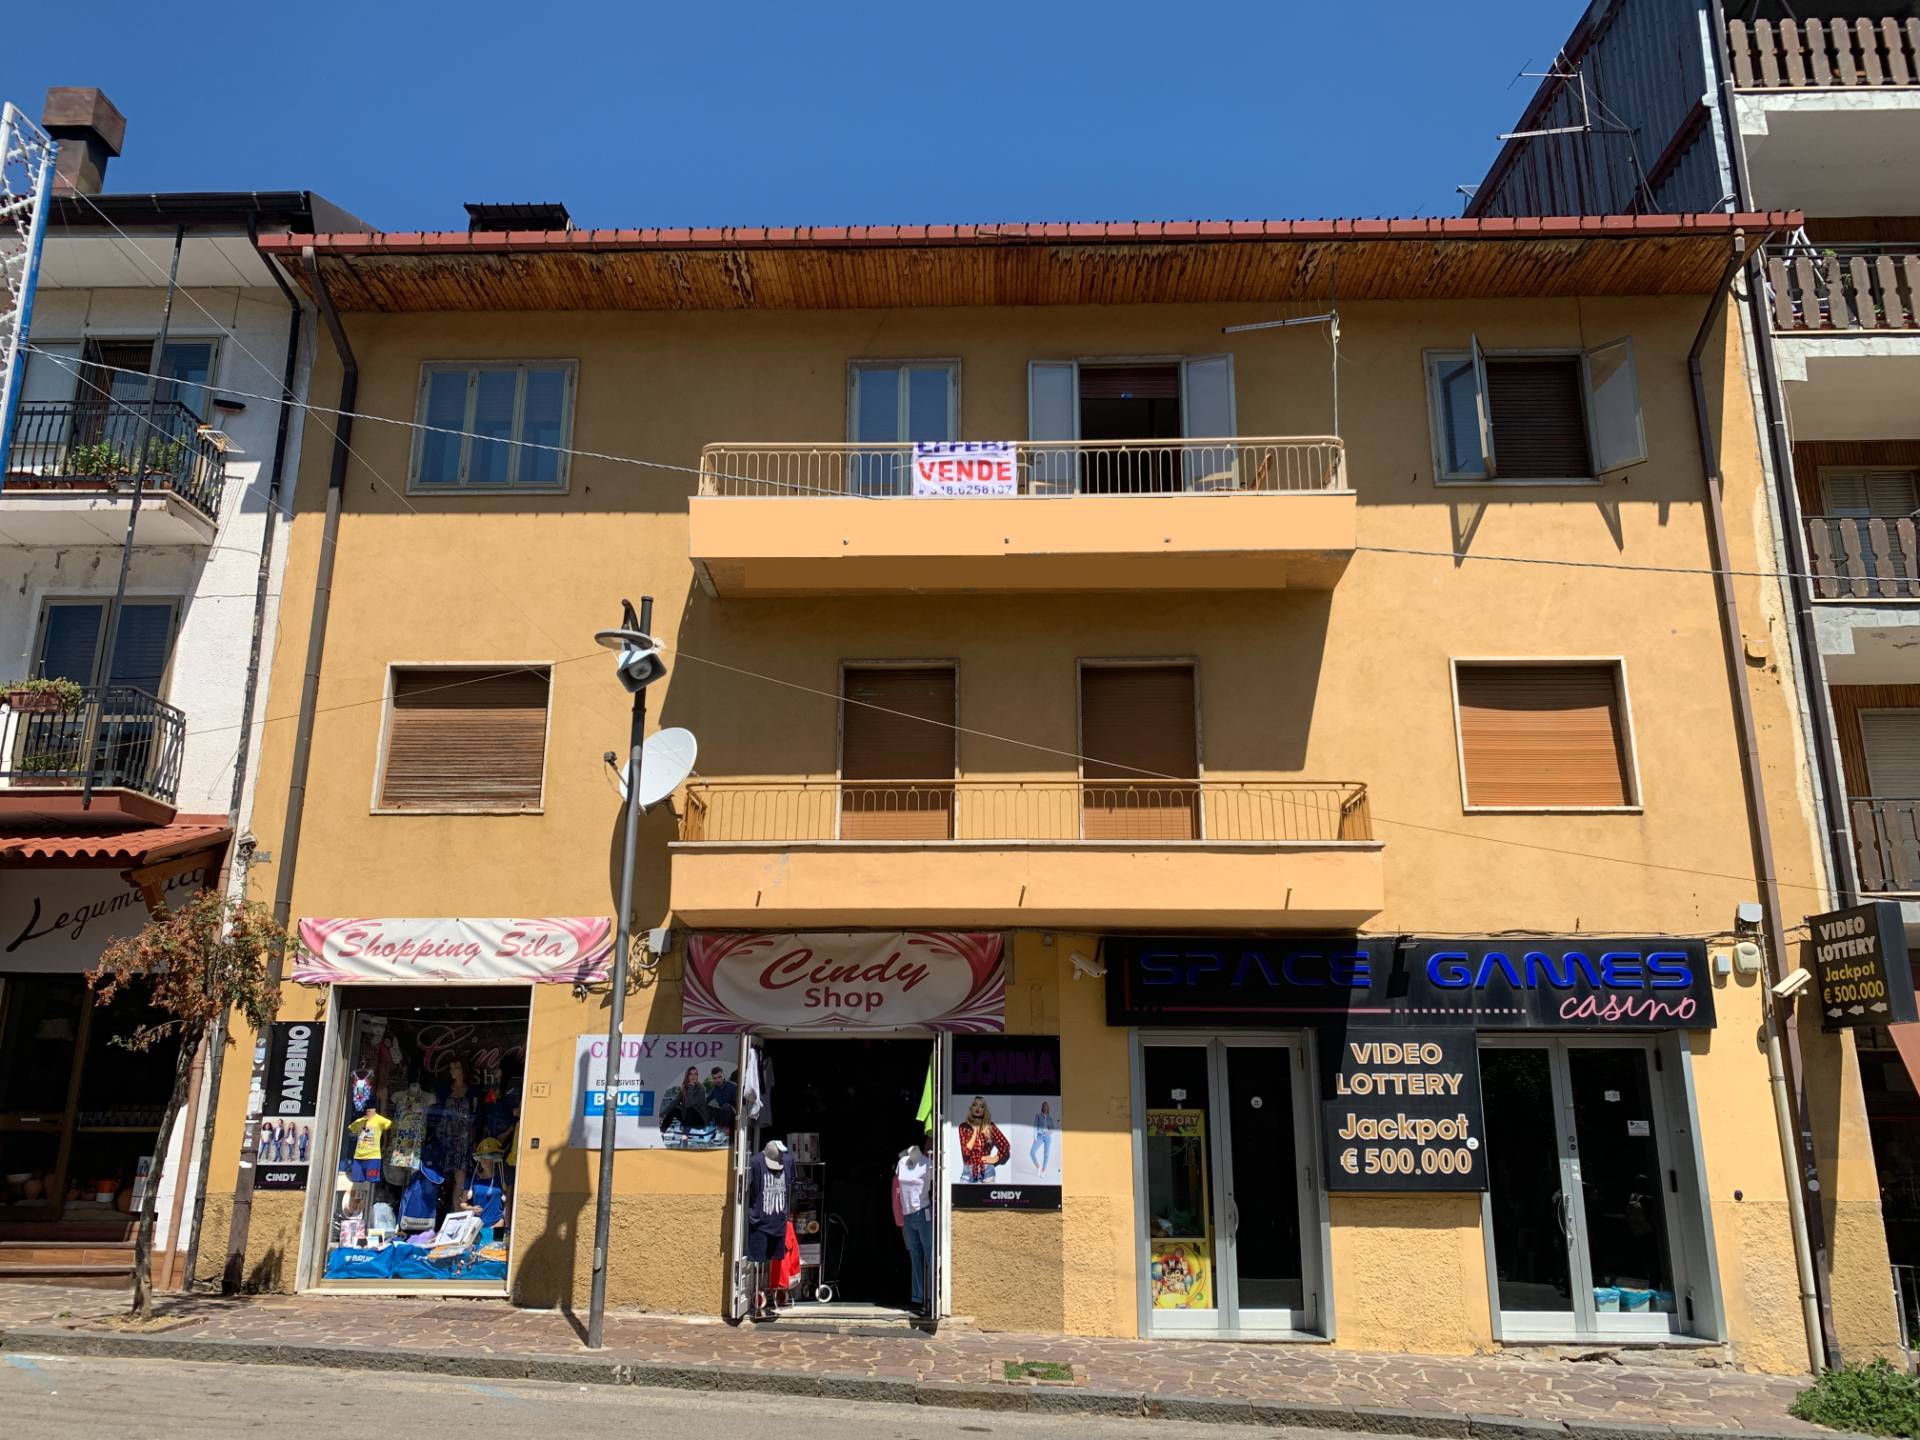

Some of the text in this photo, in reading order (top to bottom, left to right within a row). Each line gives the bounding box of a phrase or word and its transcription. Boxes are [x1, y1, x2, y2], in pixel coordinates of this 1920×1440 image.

[918, 459, 1012, 482] VENDE
[6, 868, 205, 952] Legumeia
[1819, 916, 1866, 941] VIDEO
[337, 930, 566, 965] Shopping Sila
[1817, 936, 1876, 963] LOTTERY
[758, 948, 932, 993] Cindy
[1139, 950, 1694, 989] SPACE GAMES
[1825, 960, 1876, 984] Jackpot
[804, 987, 884, 1013] Shop
[1835, 980, 1885, 1003] 500.000
[1559, 994, 1697, 1022] casino
[665, 1041, 724, 1059] SHOP
[1350, 1042, 1443, 1065] VIDEO
[278, 1025, 312, 1114] BAMBINO
[955, 1049, 1057, 1085] DONNA
[1336, 1072, 1464, 1096] LOTTERY
[593, 1093, 644, 1106] BUGI
[1338, 1113, 1469, 1146] Jackpot
[1340, 1148, 1473, 1175] € 500.000
[265, 1172, 297, 1182] CINDY
[990, 1190, 1022, 1200] CINDY
